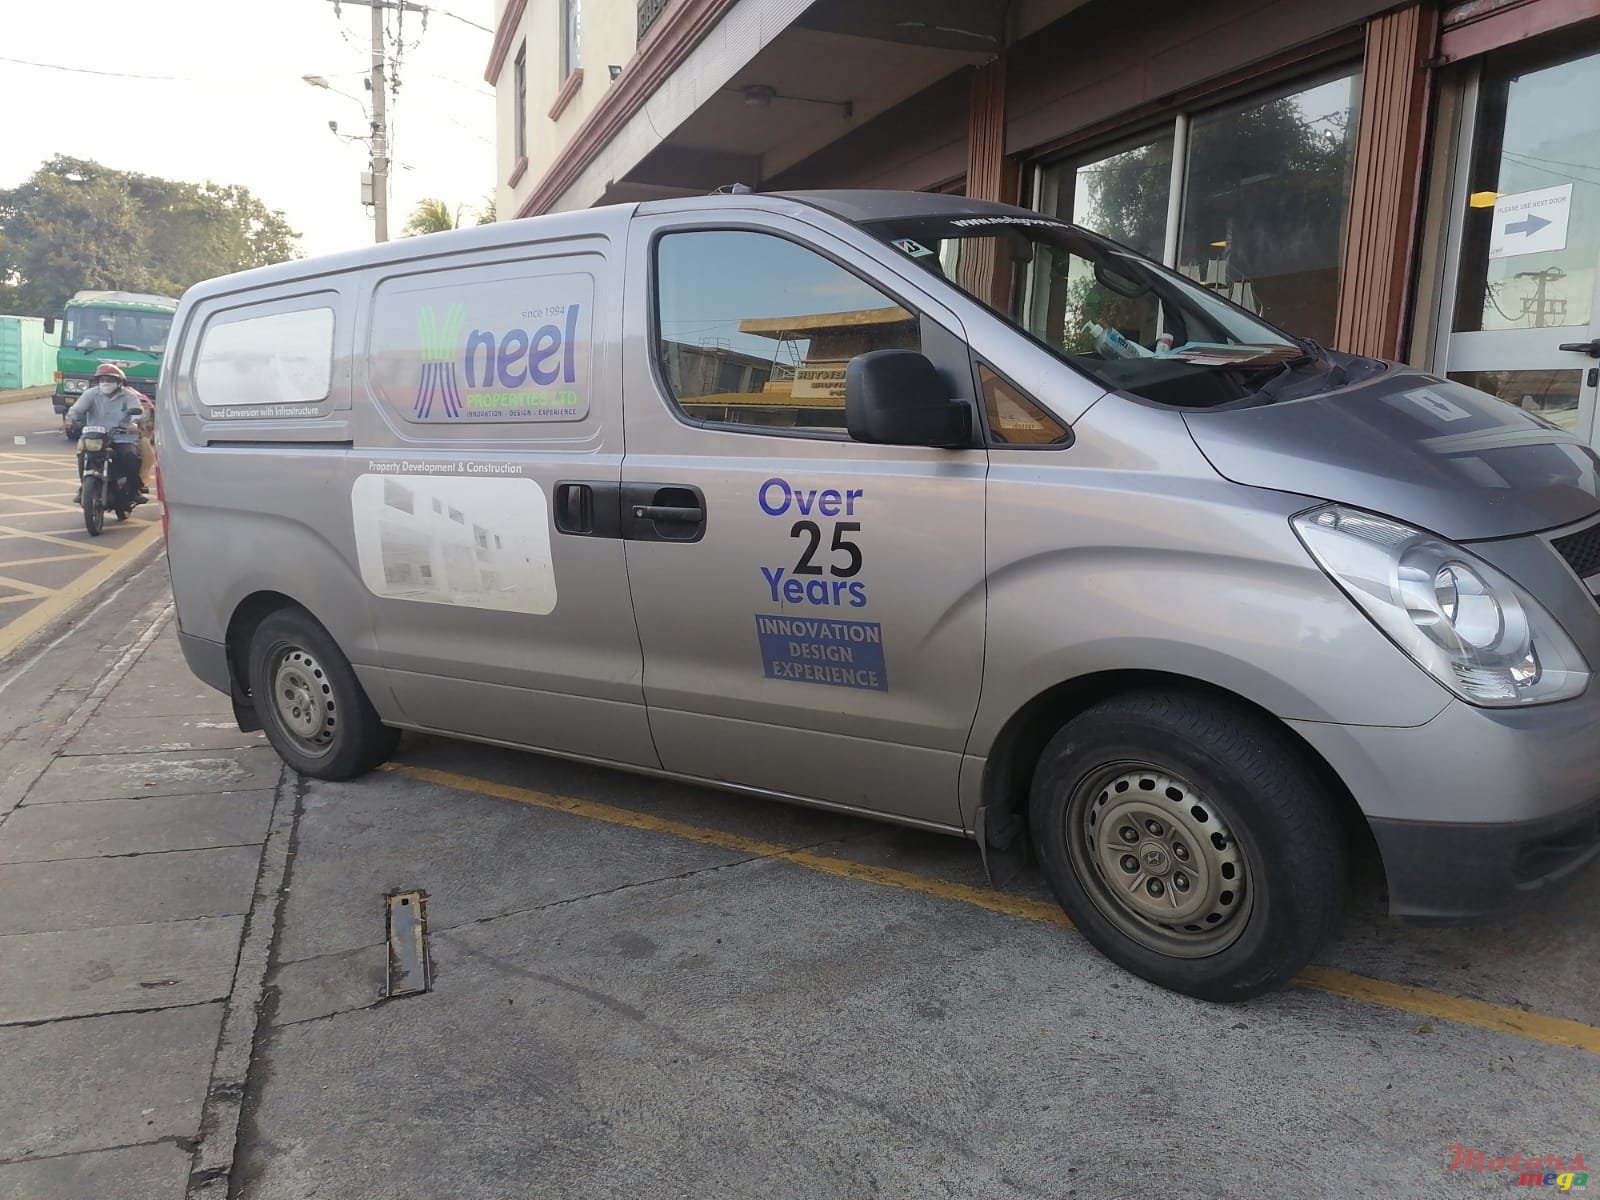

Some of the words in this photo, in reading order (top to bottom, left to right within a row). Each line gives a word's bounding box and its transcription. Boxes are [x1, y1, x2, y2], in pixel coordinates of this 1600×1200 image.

[1533, 199, 1548, 208] NEXT
[521, 309, 543, 320] since
[545, 305, 565, 317] 1994
[465, 304, 580, 389] neel
[466, 392, 548, 409] PROPERTIES
[551, 390, 577, 406] LTD
[210, 408, 225, 418] Land
[226, 407, 260, 418] Conversion
[260, 406, 274, 416] with
[275, 406, 319, 416] Infrastructure
[466, 410, 502, 418] INNOVATION
[509, 409, 532, 417] DESIGN
[538, 408, 577, 416] EXPERIENCE
[368, 460, 401, 474] Property
[402, 461, 456, 474] Development
[458, 462, 465, 472] &
[466, 462, 523, 474] Construction
[758, 477, 863, 516] Over
[790, 520, 863, 578] 25
[760, 566, 868, 608] Years
[759, 618, 881, 644] INNOVATION
[789, 641, 854, 663] DESIGN
[772, 660, 880, 687] EXPERIENCE
